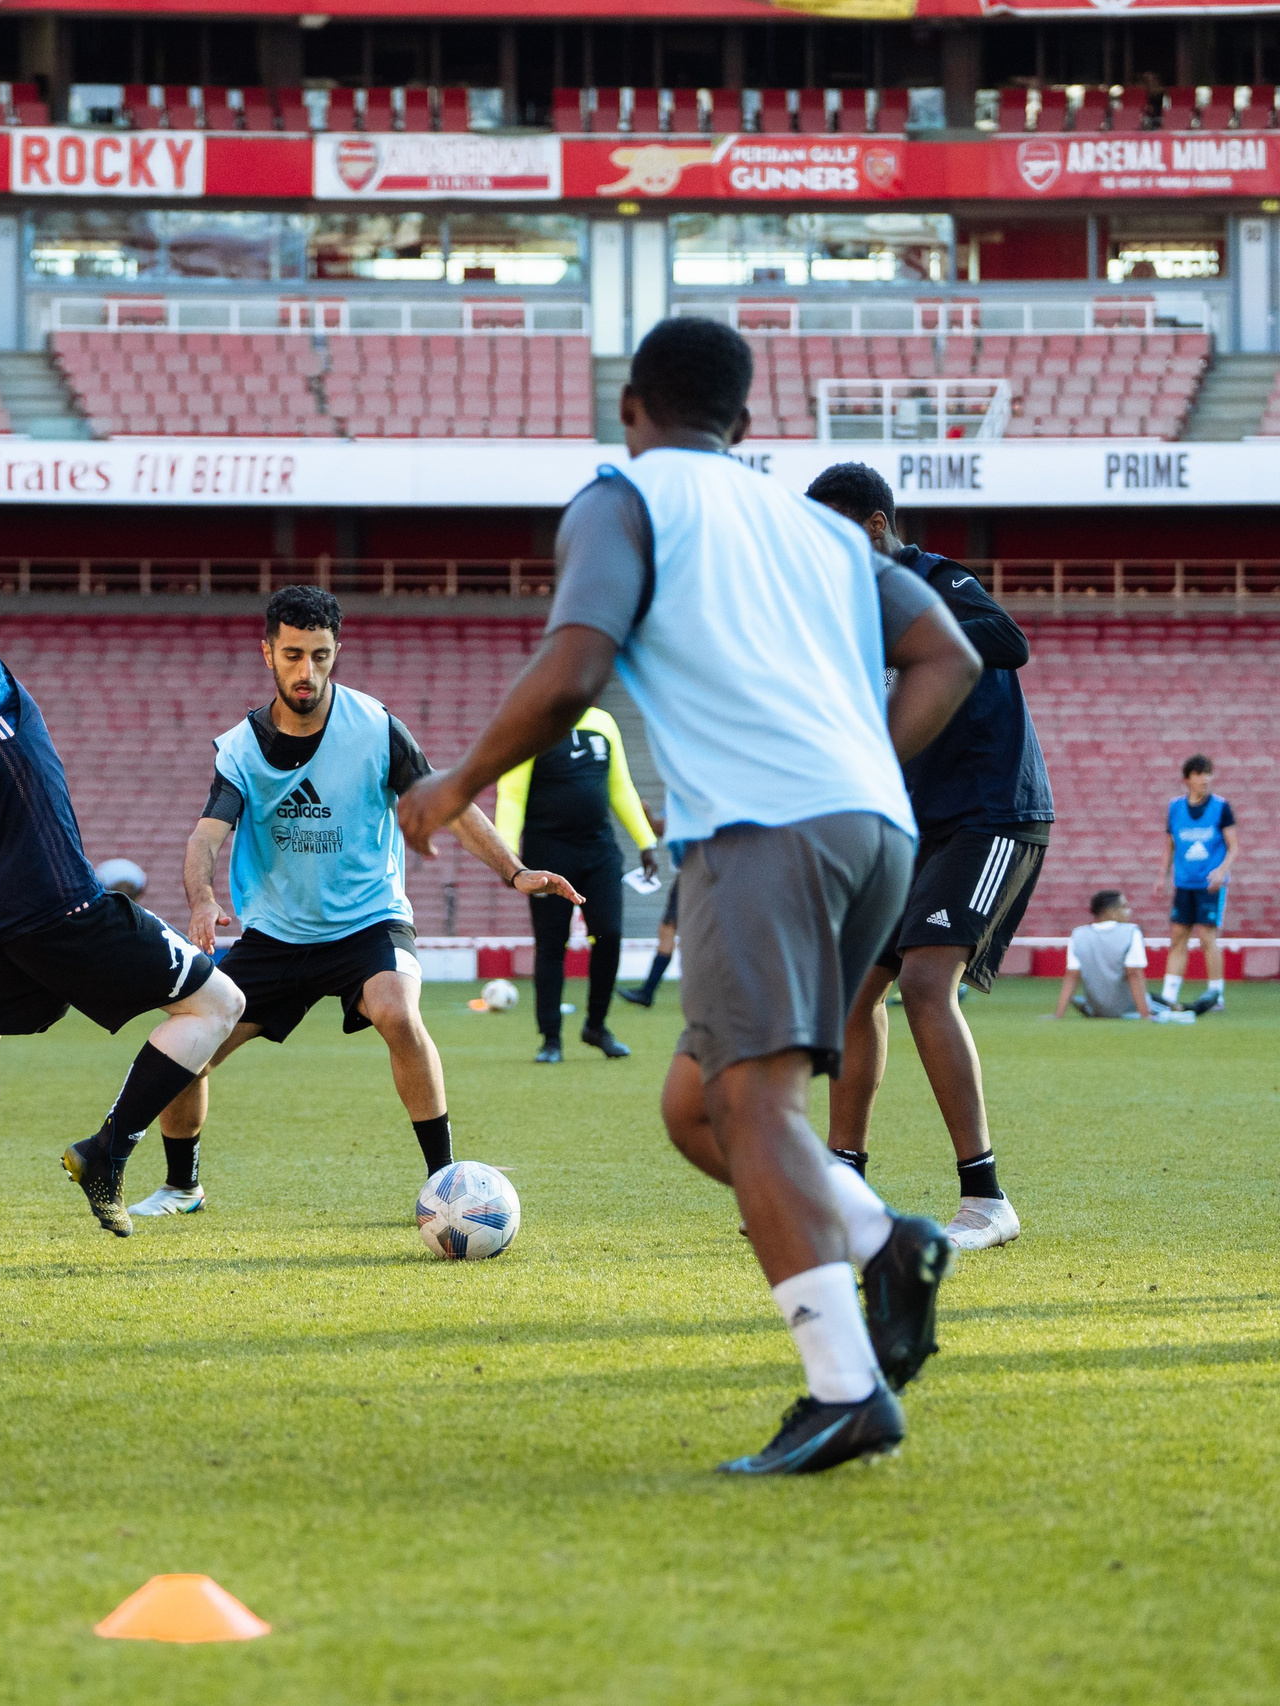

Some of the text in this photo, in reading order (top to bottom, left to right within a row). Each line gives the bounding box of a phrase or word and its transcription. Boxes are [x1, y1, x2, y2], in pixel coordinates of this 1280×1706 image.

[21, 134, 193, 189] ROCKY
[1067, 139, 1267, 173] ARSENAL MUMBAI
[730, 167, 859, 191] GUNNERS
[131, 453, 183, 494] FLY
[190, 454, 297, 495] BETTER
[899, 453, 982, 490] PRIME
[1106, 452, 1190, 489] PRIME
[276, 803, 332, 819] adidas
[291, 825, 344, 842] Arsenal
[291, 841, 343, 854] COMMUNITY
[926, 916, 951, 928] adidas
